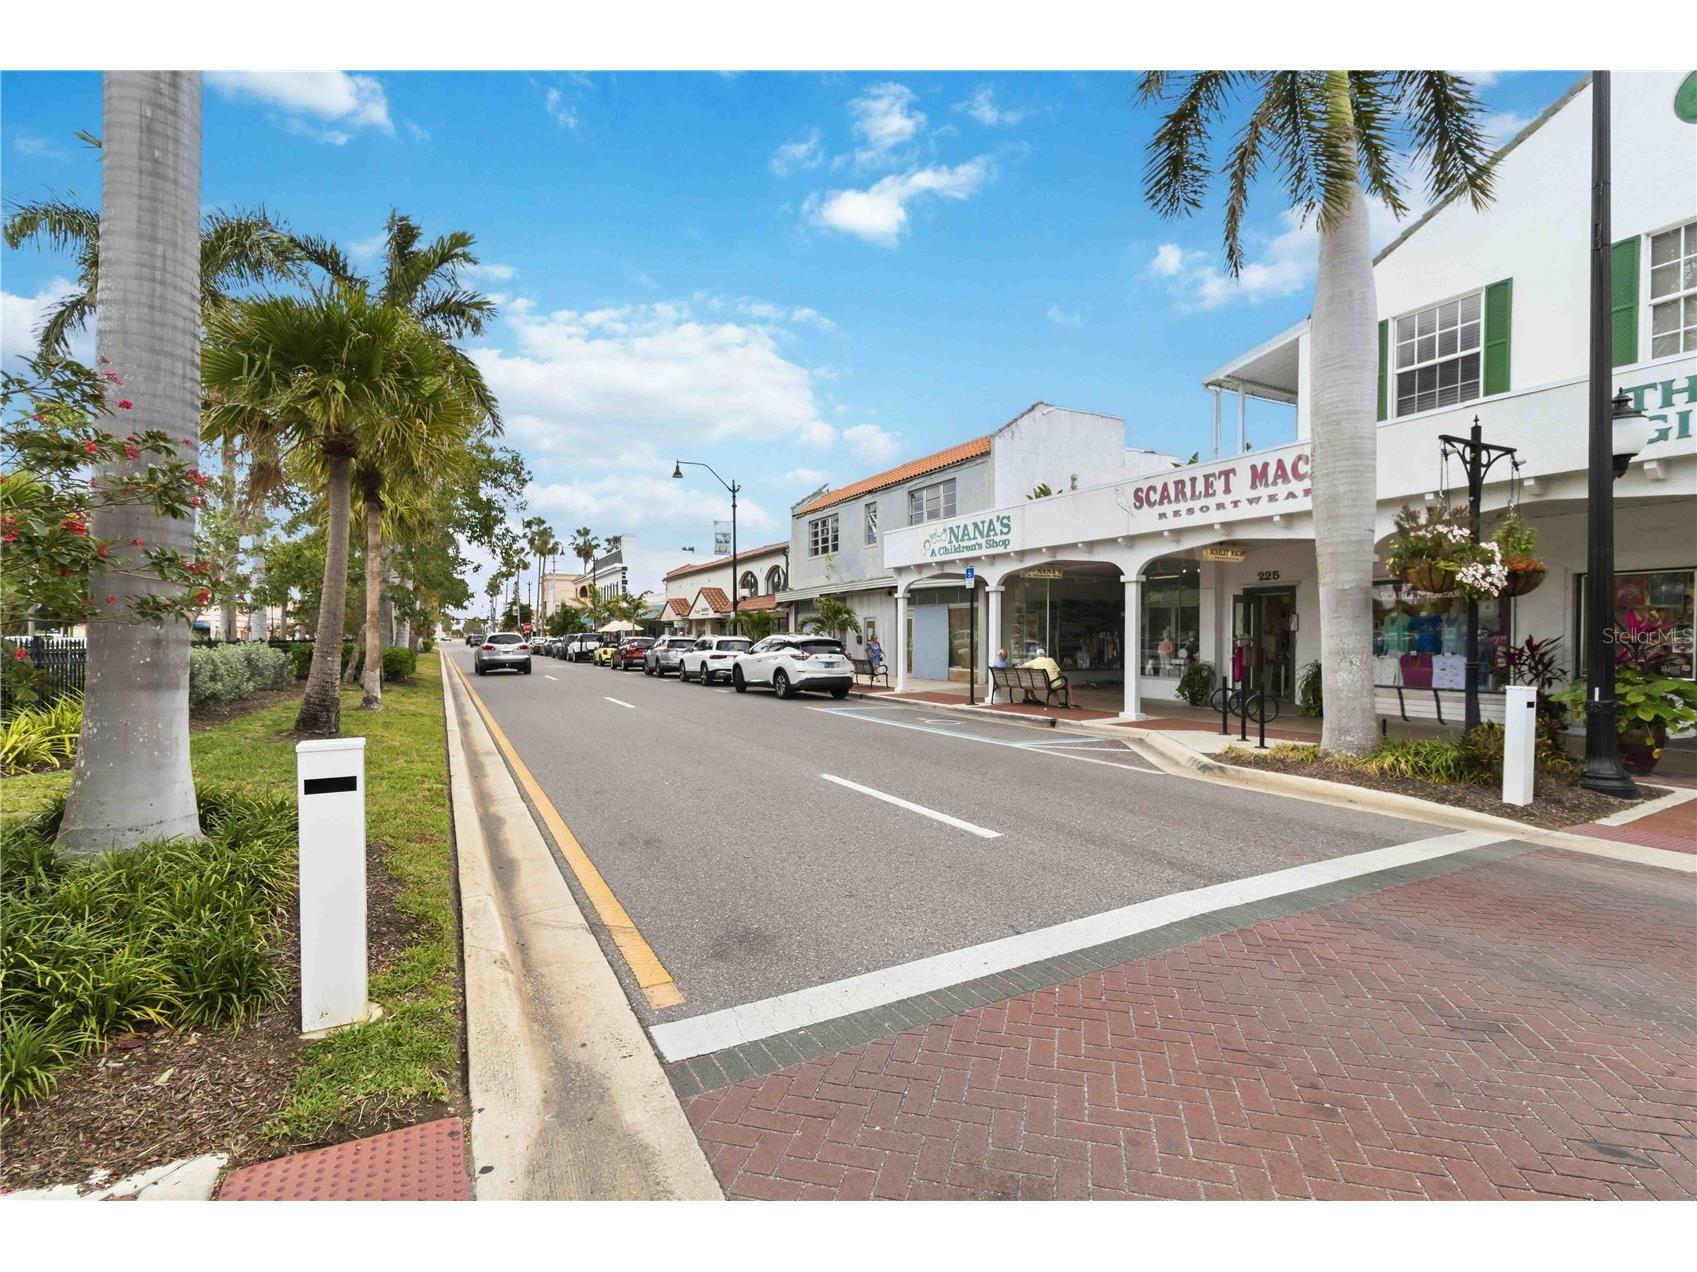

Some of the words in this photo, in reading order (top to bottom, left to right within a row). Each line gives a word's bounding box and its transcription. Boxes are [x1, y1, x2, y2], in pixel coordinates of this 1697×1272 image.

[1133, 468, 1237, 510] SCARLET
[1250, 454, 1312, 490] MAC
[947, 515, 1011, 544] NANA'S
[930, 548, 936, 557] A
[938, 541, 983, 556] Children's
[985, 538, 1010, 549] Shop
[1257, 570, 1280, 581] 225
